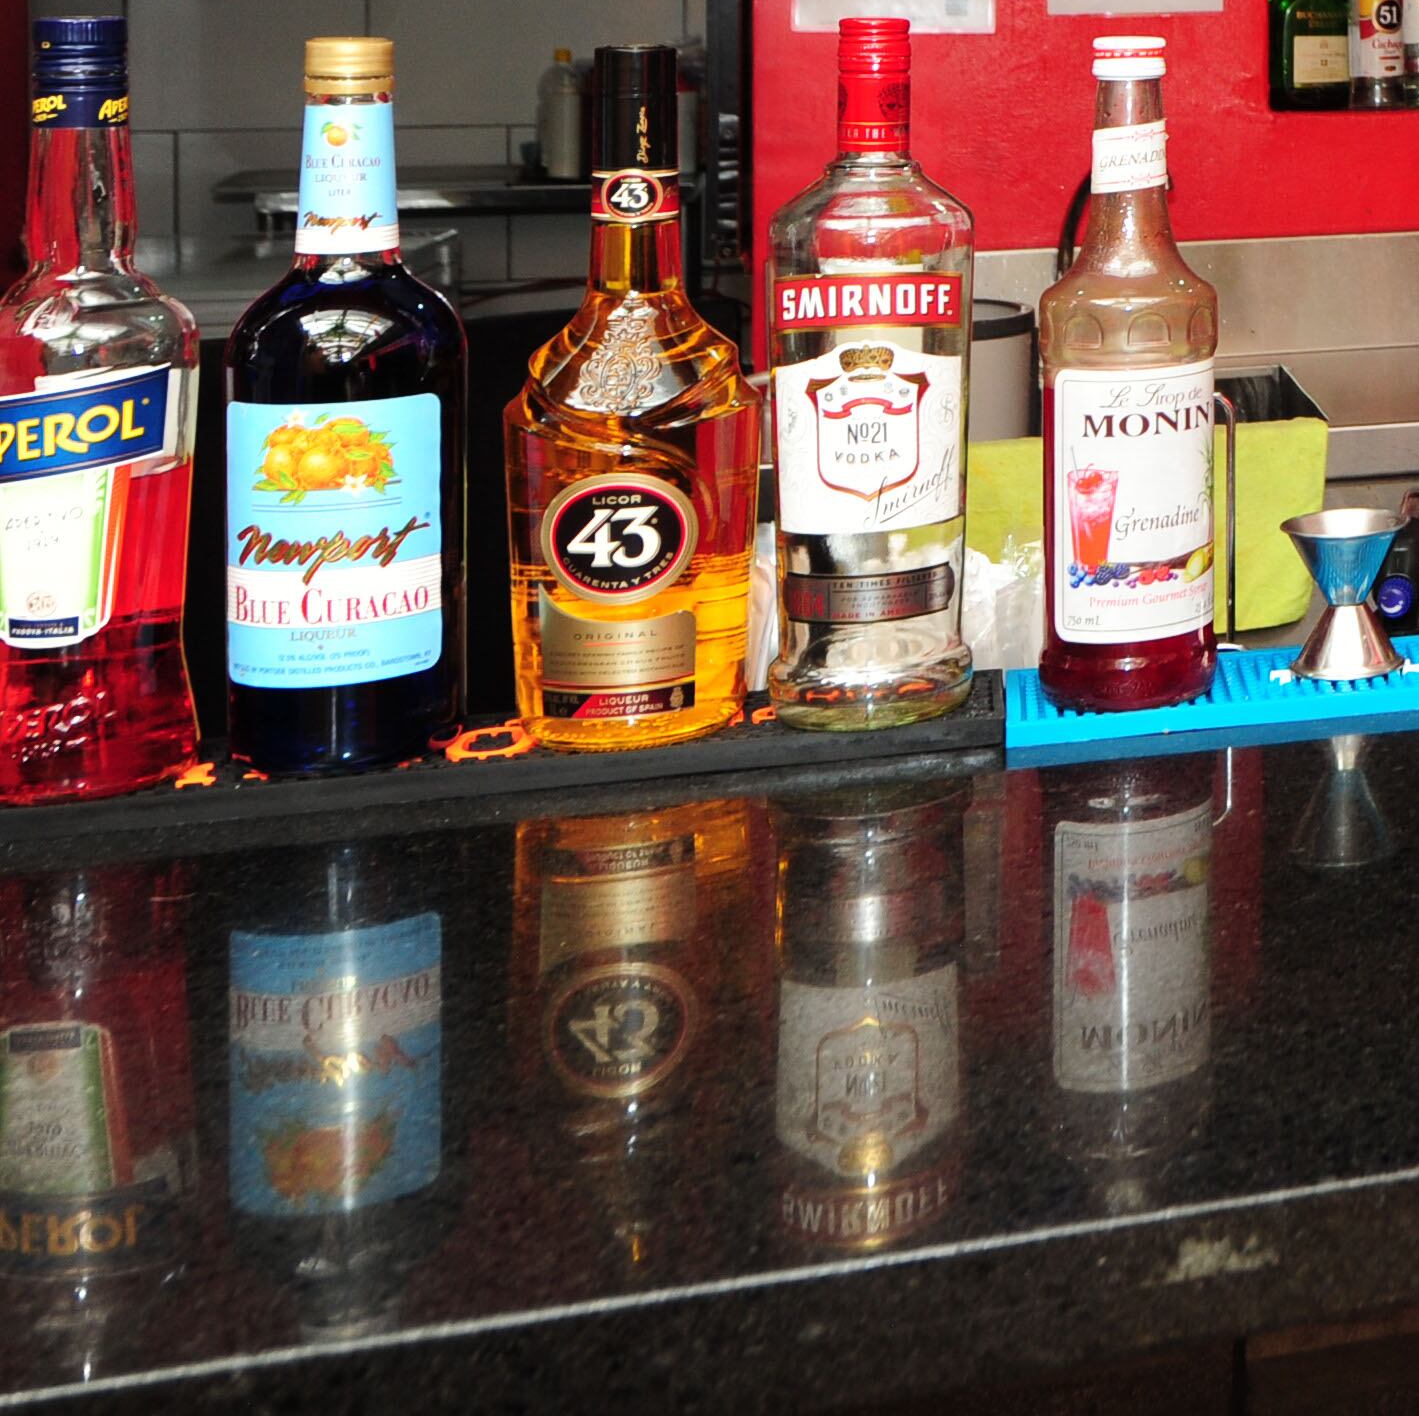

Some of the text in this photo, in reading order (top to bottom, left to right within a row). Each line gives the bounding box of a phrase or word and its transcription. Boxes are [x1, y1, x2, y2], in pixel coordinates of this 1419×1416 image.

[1379, 5, 1398, 25] 51
[306, 155, 328, 169] BLUE
[610, 183, 649, 209] 43
[782, 284, 952, 321] SMIRNOFF
[1099, 385, 1131, 409] Le
[1137, 383, 1185, 411] Sirop
[1082, 400, 1210, 438] MONIN
[835, 450, 900, 464] VODKA
[865, 444, 955, 526] Smirnoff
[592, 494, 642, 506] LICOR
[1115, 503, 1201, 541] Grenadine
[567, 505, 662, 568] 43
[236, 516, 431, 585] Newport
[632, 576, 640, 586] Y
[645, 551, 674, 580] TRES
[833, 581, 853, 589] TEN
[858, 579, 891, 588] TIMES
[235, 585, 429, 625] BLUE CURACAO
[1089, 594, 1139, 609] Premium
[1142, 587, 1188, 605] Gourmet
[290, 627, 357, 642] LIQUEUR
[572, 629, 658, 641] ORIGINAL
[585, 705, 624, 716] PRODUCT
[626, 705, 637, 714] OF
[599, 694, 649, 705] LIQUEUR
